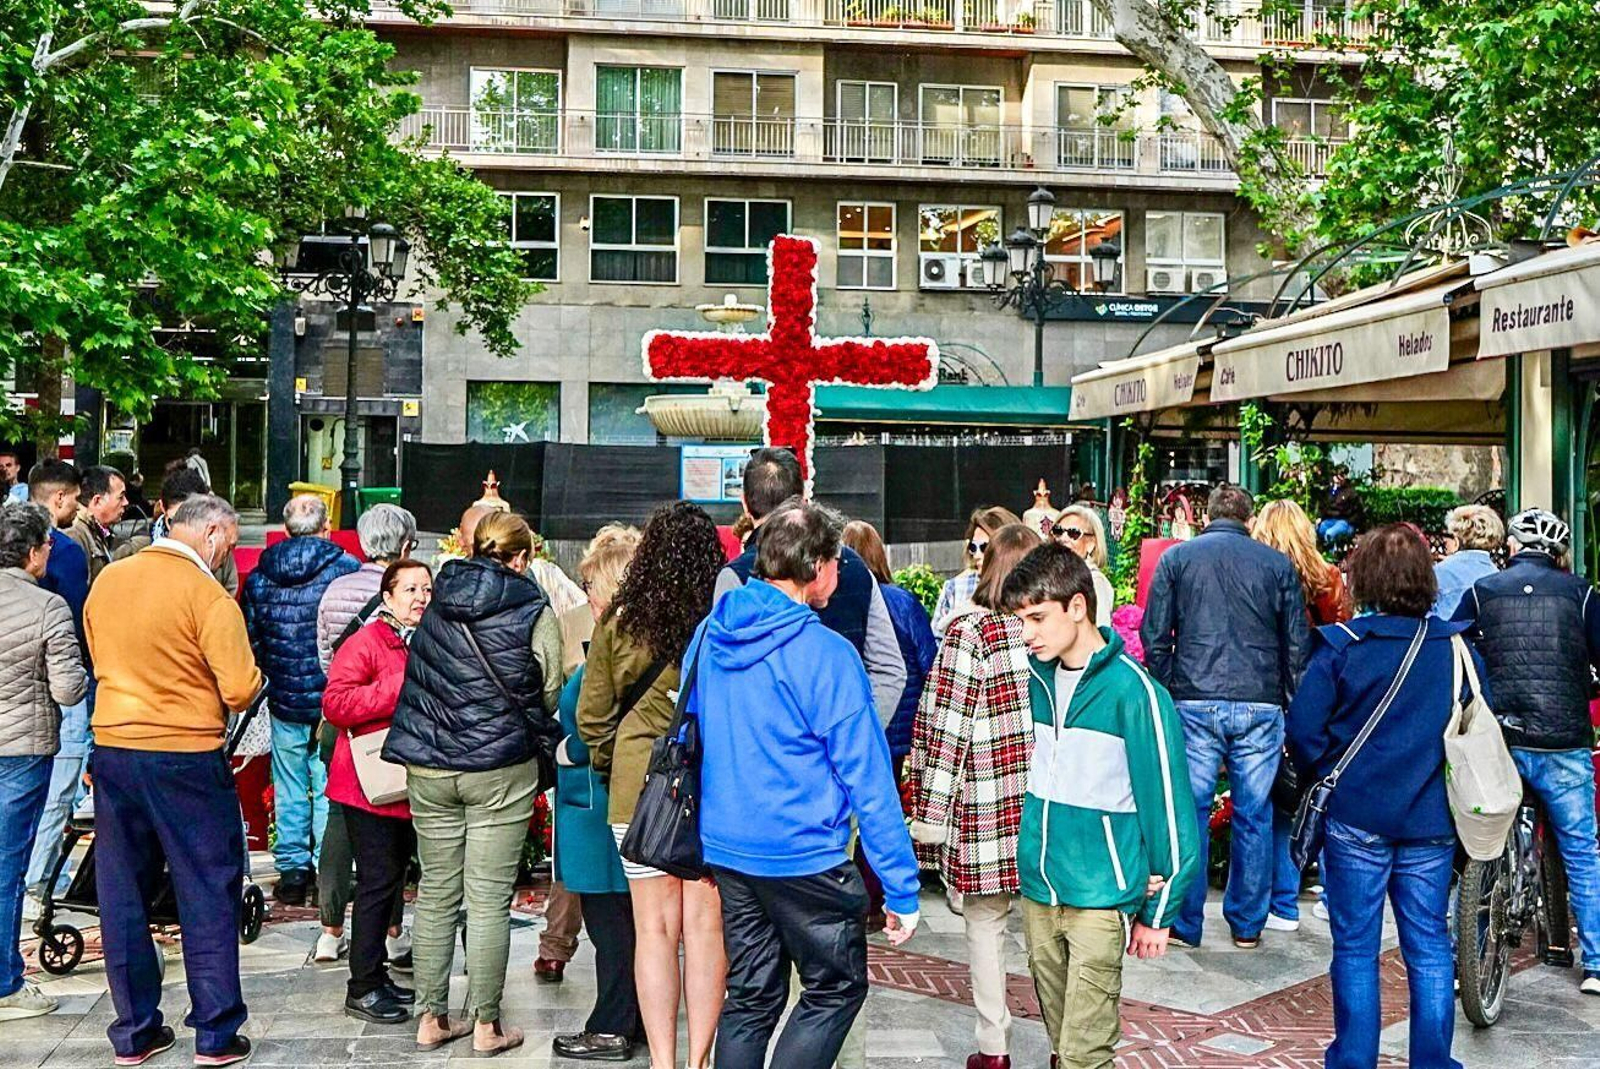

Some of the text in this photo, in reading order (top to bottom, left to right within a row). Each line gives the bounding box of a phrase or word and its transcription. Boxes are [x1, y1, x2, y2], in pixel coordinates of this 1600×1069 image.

[1492, 295, 1573, 333] Restaurante
[1286, 342, 1343, 382] CHIKITO
[1398, 331, 1433, 358] Helados
[1115, 378, 1147, 407] CHIKITO
